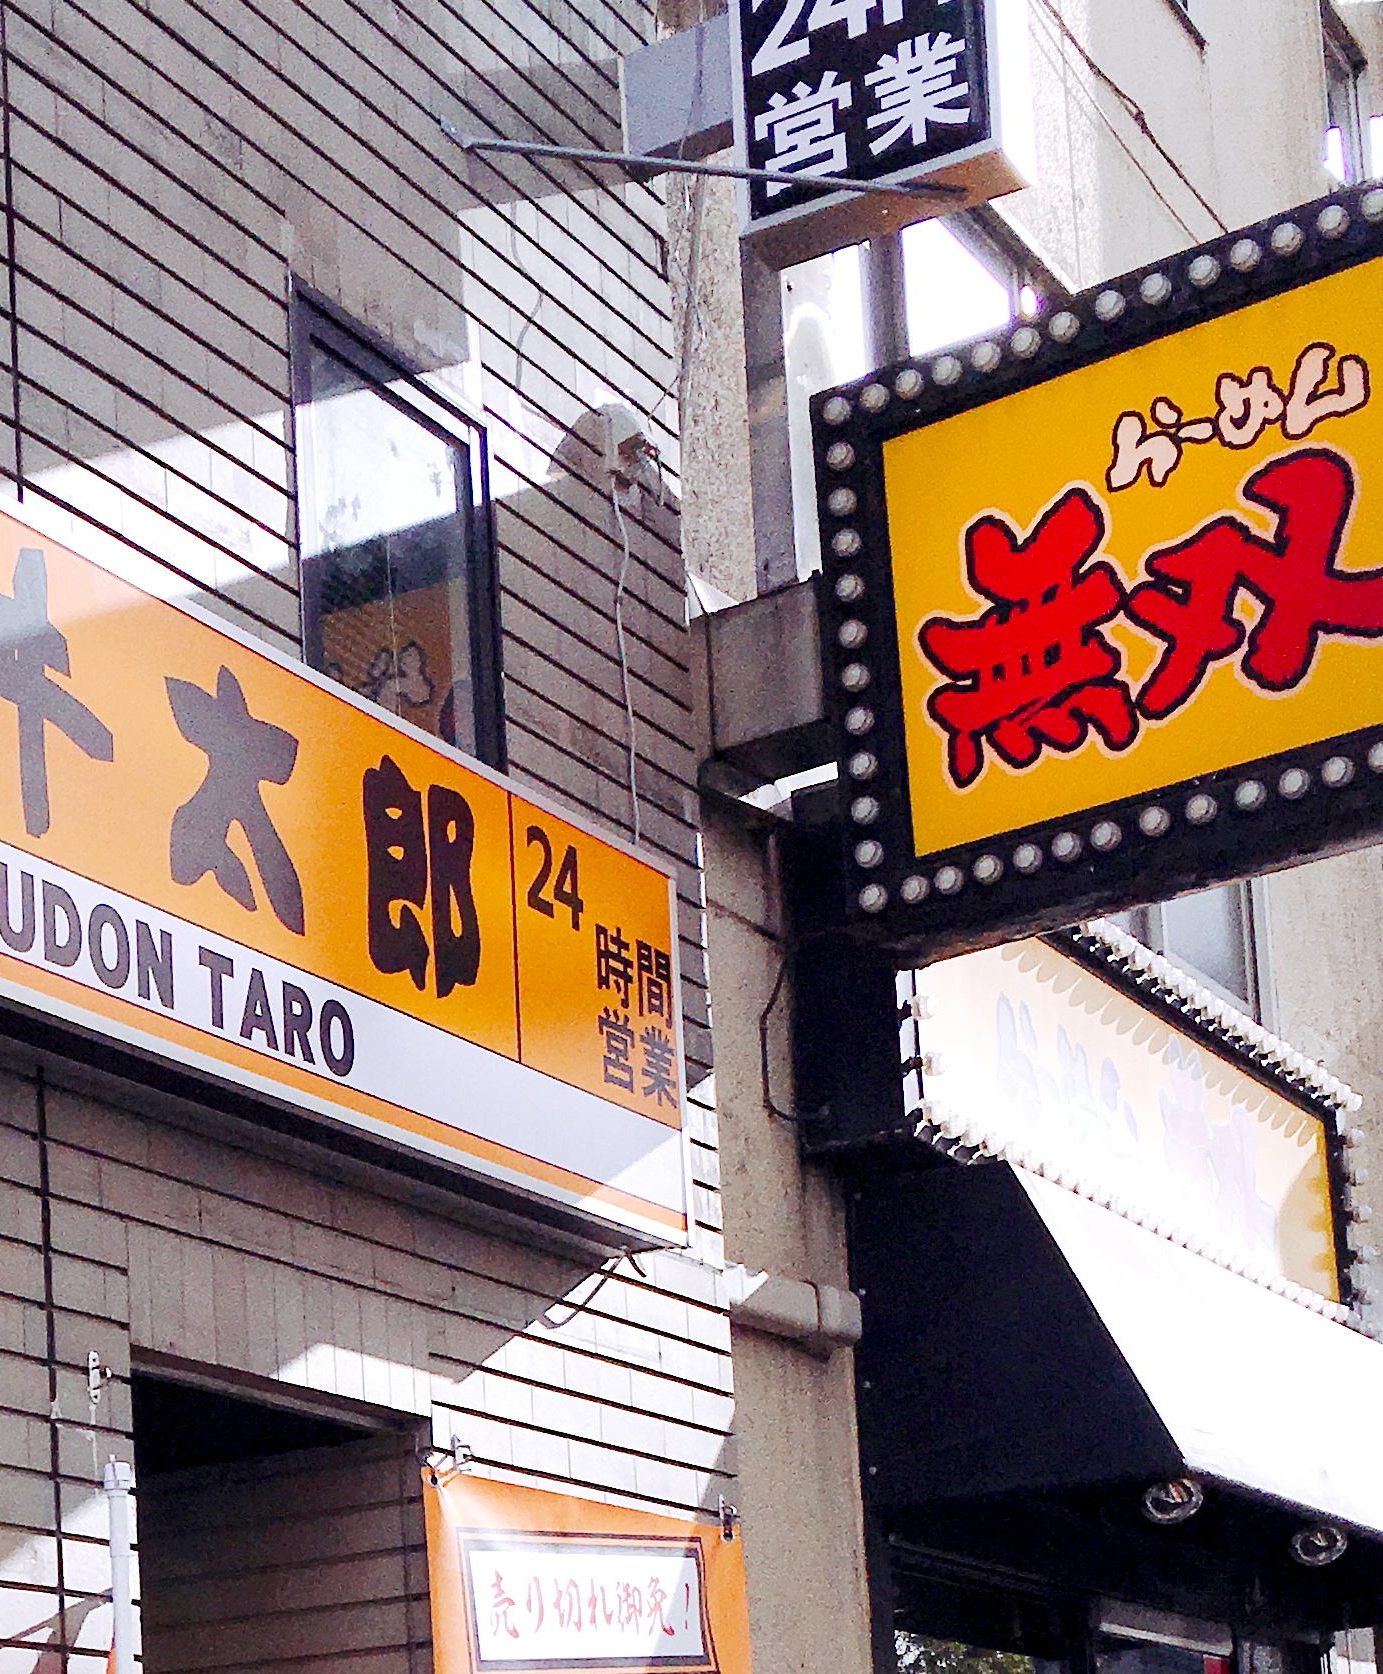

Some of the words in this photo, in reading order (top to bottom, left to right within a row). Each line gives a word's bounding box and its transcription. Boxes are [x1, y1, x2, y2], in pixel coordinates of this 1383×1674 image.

[753, 31, 971, 197] 営業
[1106, 342, 1371, 492] らーめん
[526, 824, 584, 932] 24
[198, 949, 355, 1077] TARO
[595, 922, 673, 1029] 時間
[597, 1006, 678, 1109] 営業
